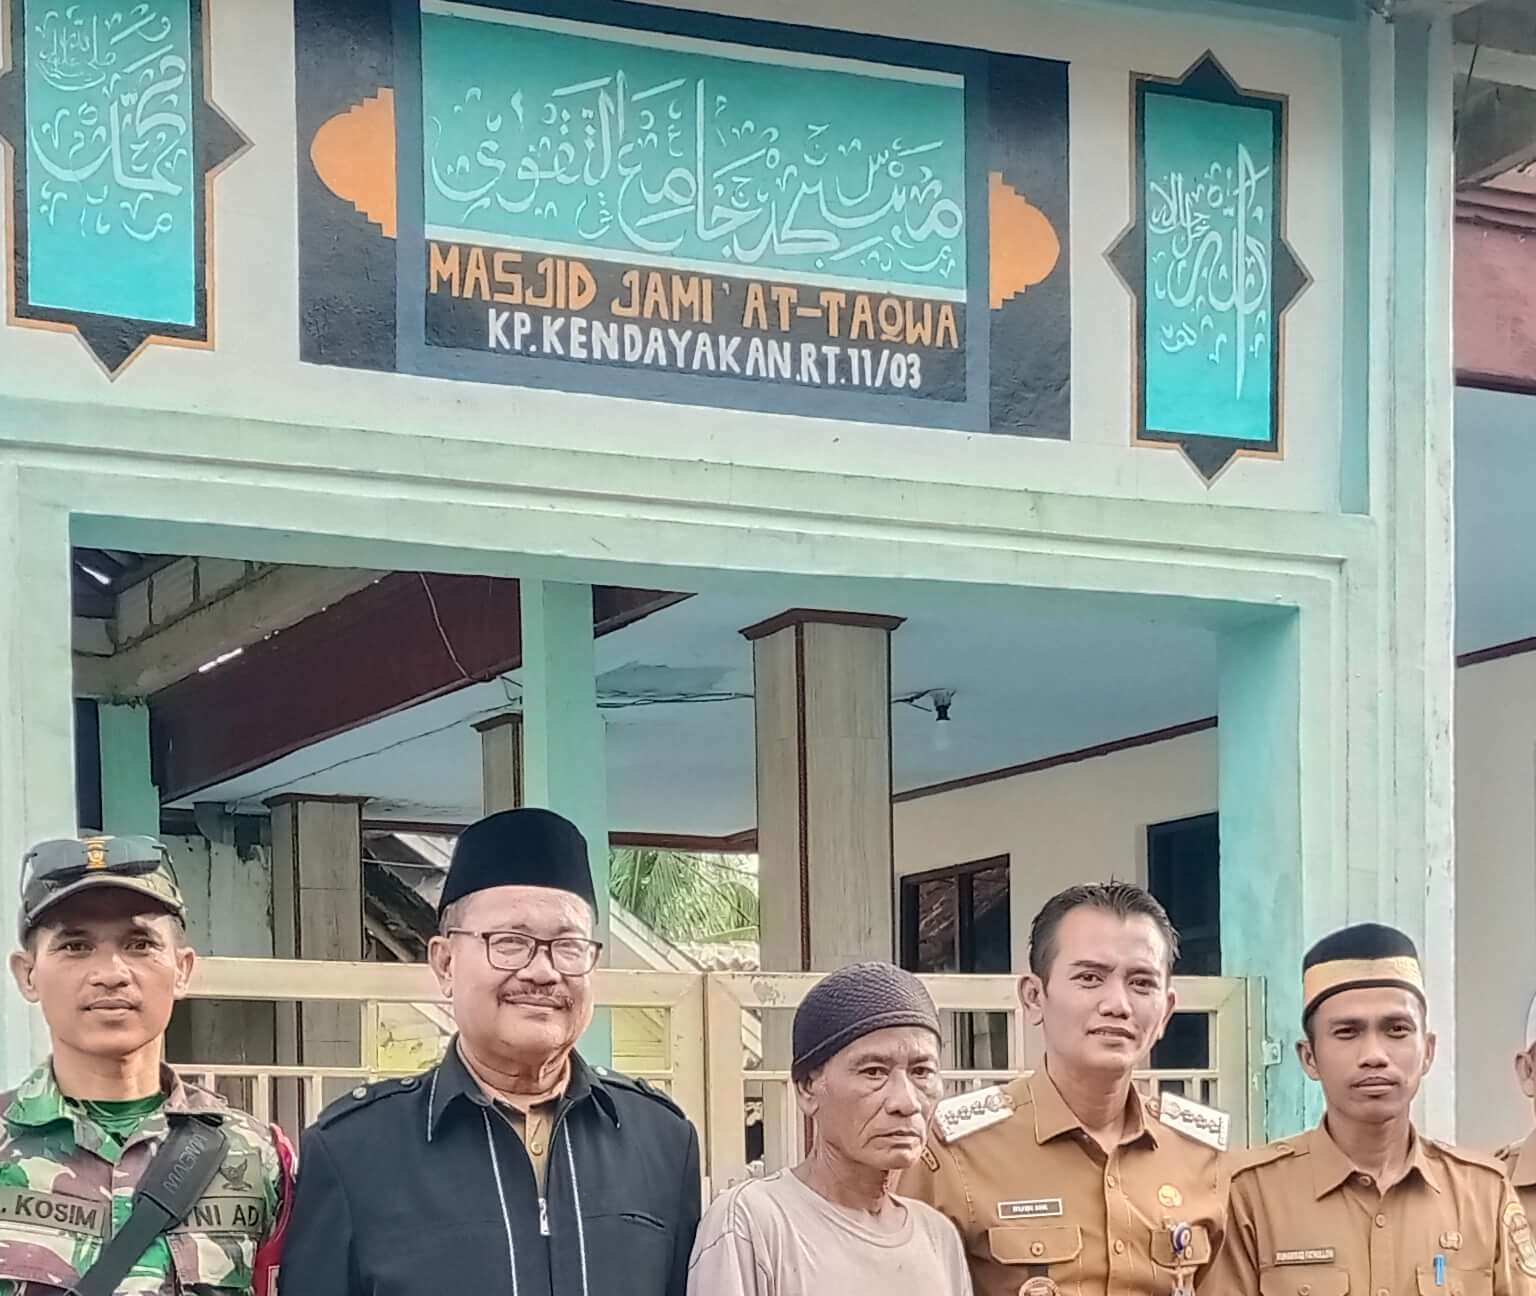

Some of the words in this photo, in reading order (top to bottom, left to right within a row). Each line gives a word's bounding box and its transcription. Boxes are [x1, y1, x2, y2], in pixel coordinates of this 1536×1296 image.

[429, 242, 597, 311] MASJID
[742, 282, 960, 349] AT-TAQWA
[15, 1194, 97, 1230] KOSIM
[232, 1204, 259, 1227] AD
